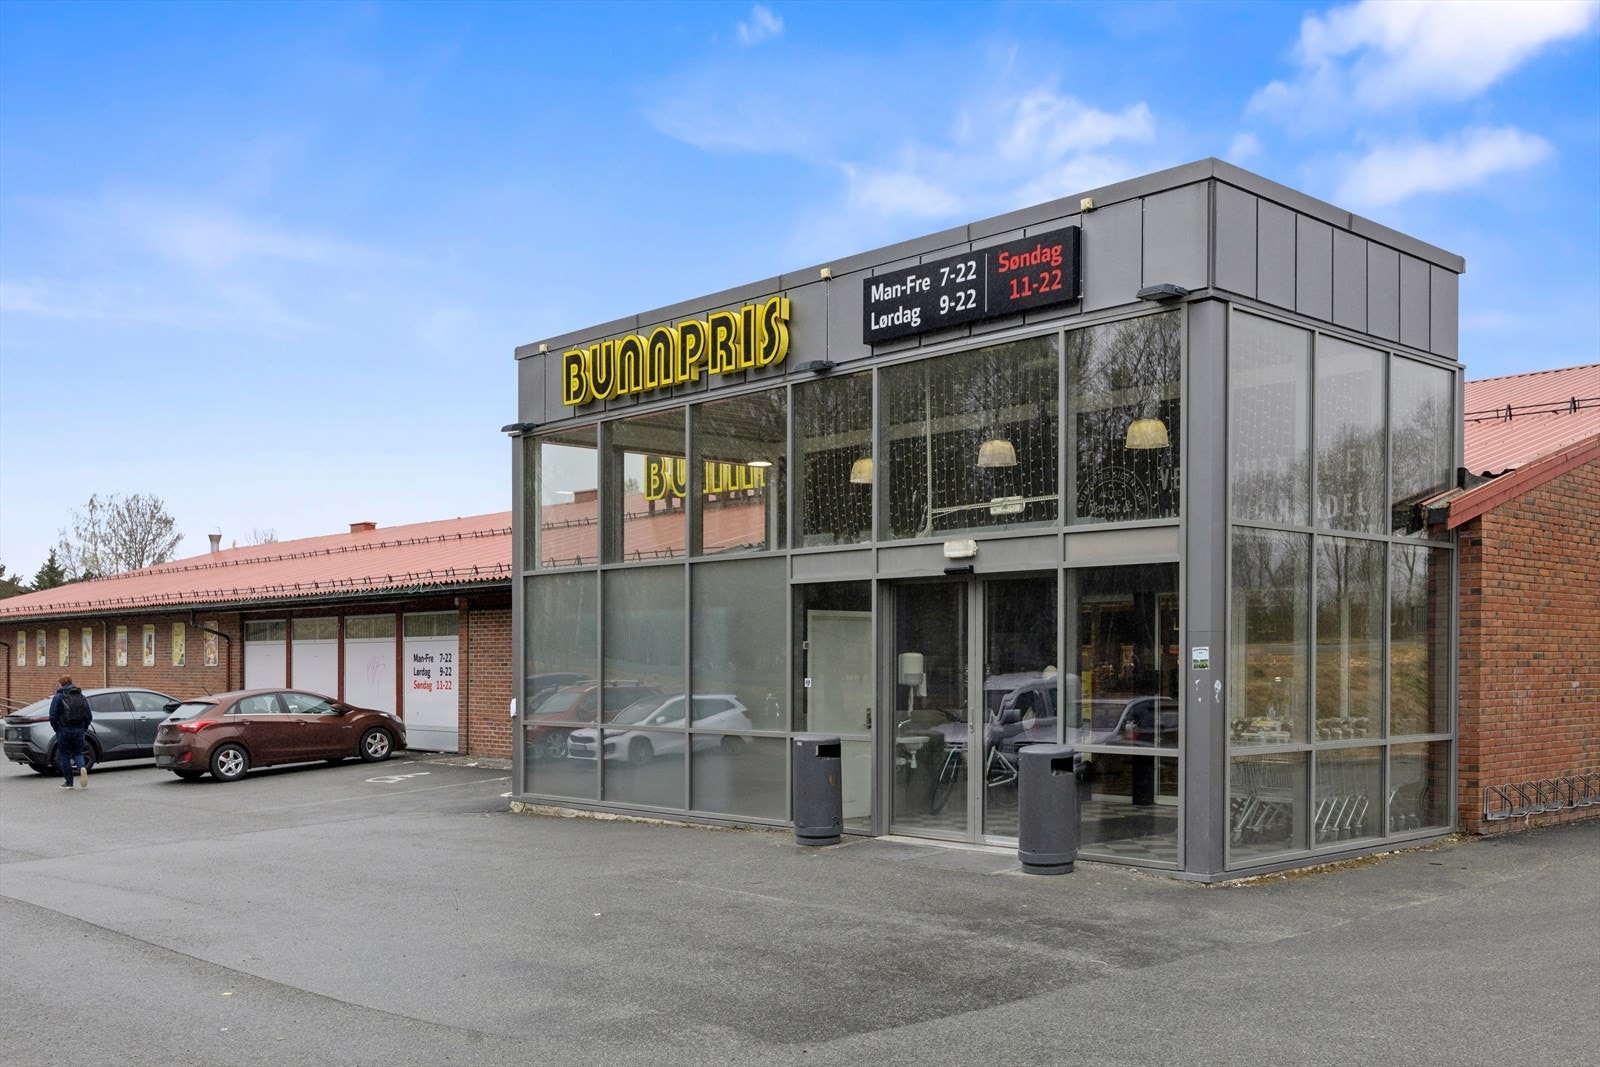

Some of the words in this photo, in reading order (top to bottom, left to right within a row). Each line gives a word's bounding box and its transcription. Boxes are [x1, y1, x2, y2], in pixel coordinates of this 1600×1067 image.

[998, 243, 1063, 273] Søndag
[870, 274, 931, 303] Man-Fre
[939, 260, 977, 287] 7-22
[1009, 269, 1063, 300] 11-22
[870, 305, 921, 330] Lørdag
[939, 289, 977, 315] 9-22
[562, 296, 790, 406] BUNNPRIS
[413, 653, 434, 663] Man-Fre
[439, 653, 453, 663] 7-22
[413, 667, 431, 679] Lørdag
[439, 666, 453, 677] 9-22
[413, 680, 433, 692] Søndag
[436, 680, 453, 690] 11-22
